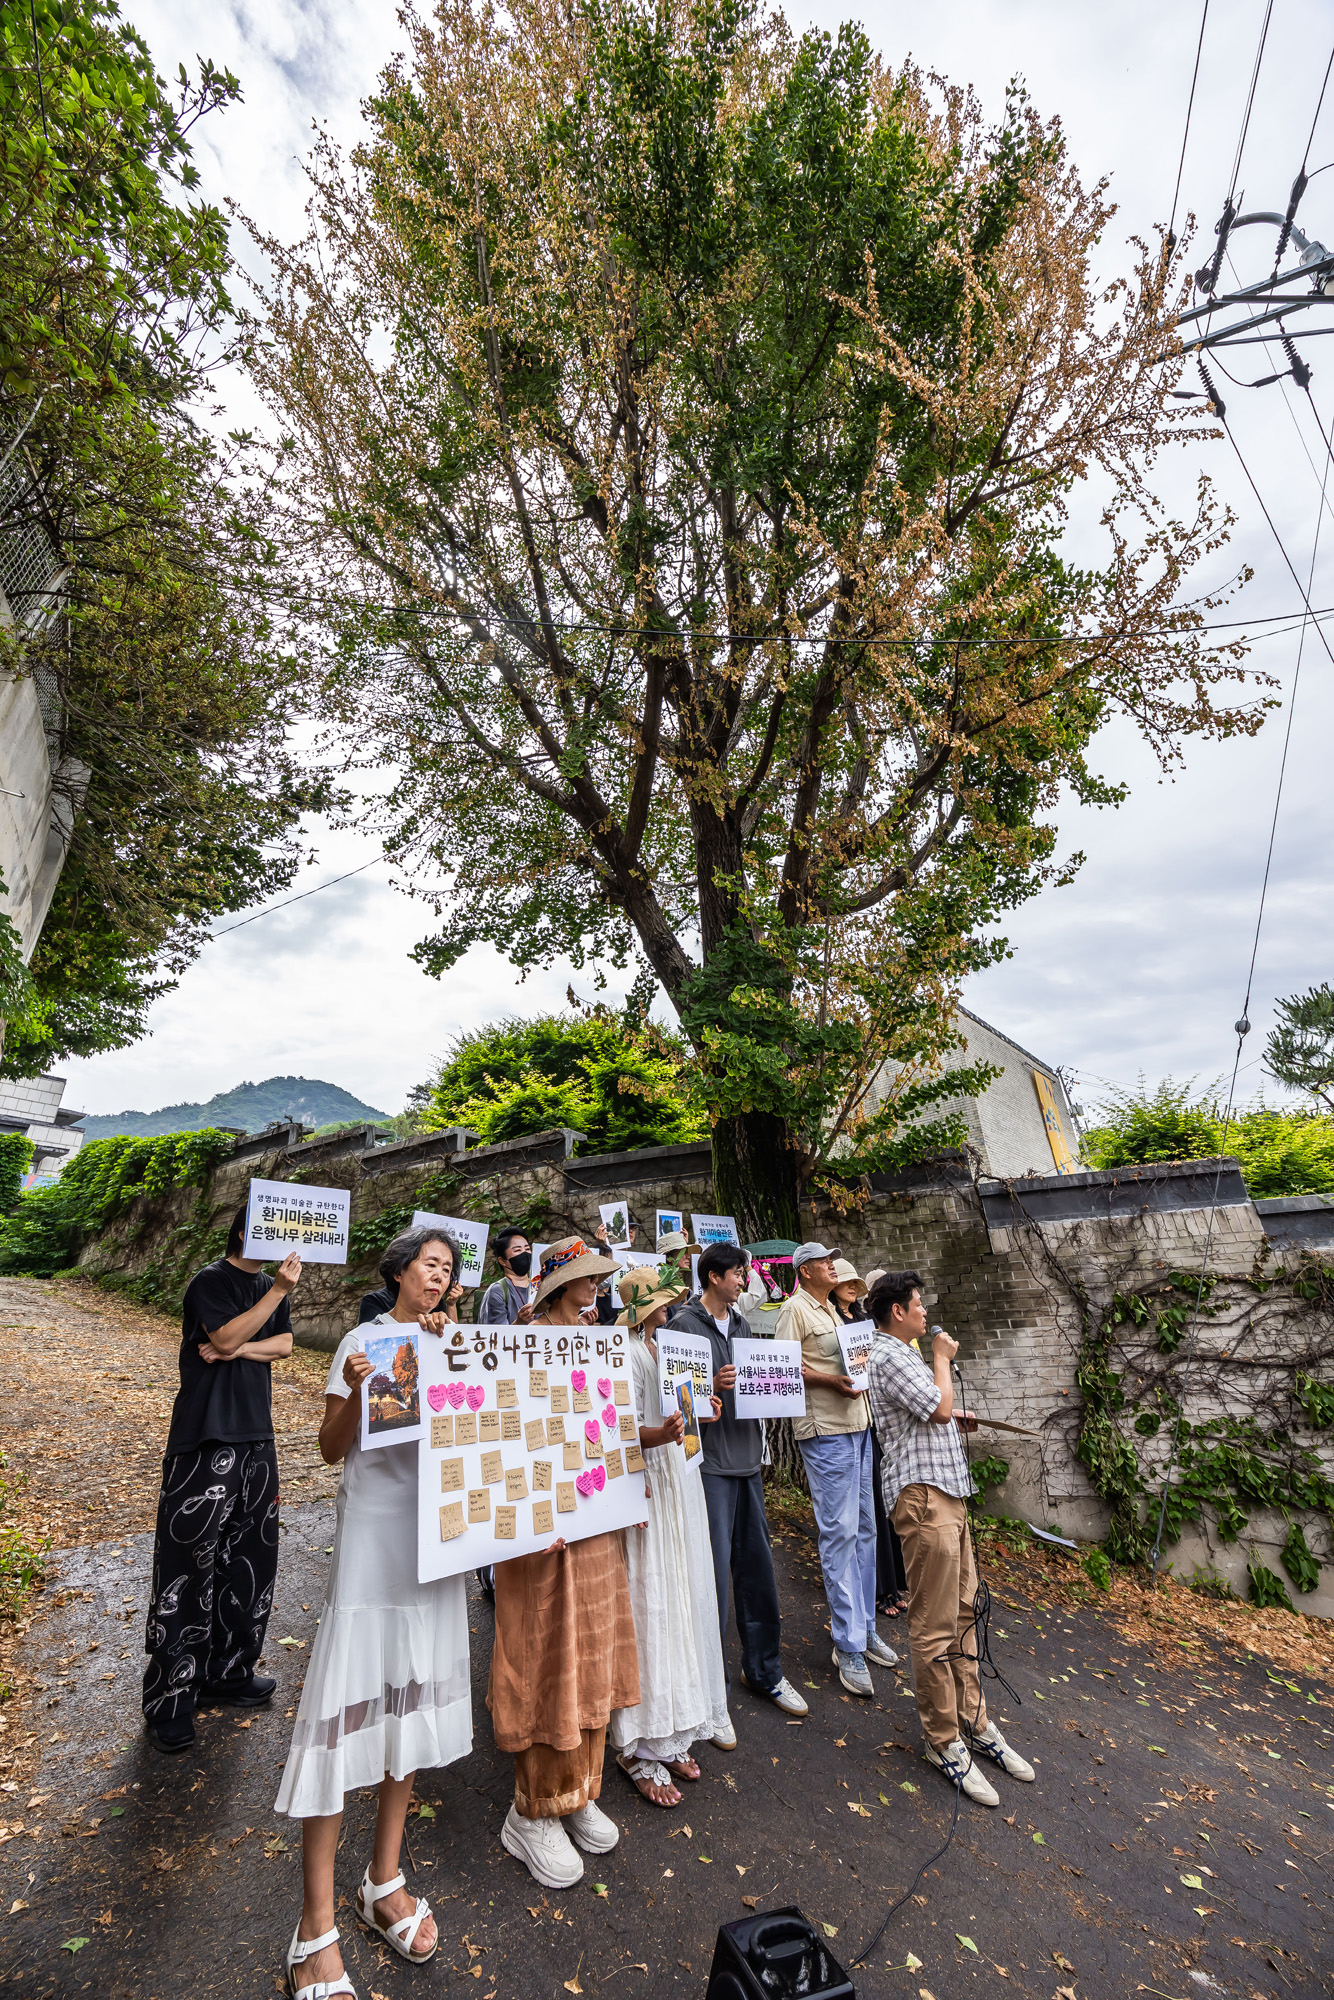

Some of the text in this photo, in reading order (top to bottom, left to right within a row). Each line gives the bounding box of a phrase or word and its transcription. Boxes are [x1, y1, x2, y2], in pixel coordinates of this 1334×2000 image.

[257, 1194, 345, 1211] 생명파괴 미술관 규탄한다
[262, 1205, 339, 1229] 환기미술관은
[251, 1225, 345, 1246] 은행나무 살려내라
[699, 1228, 733, 1238] 환기미술관은
[596, 1333, 625, 1368] 마음
[750, 1354, 766, 1362] 사유지
[780, 1355, 790, 1363] 그만
[666, 1357, 708, 1379] 환기미술관은
[738, 1366, 800, 1379] 서울시는 은행나무를
[739, 1382, 803, 1396] 보호수로 지정하라
